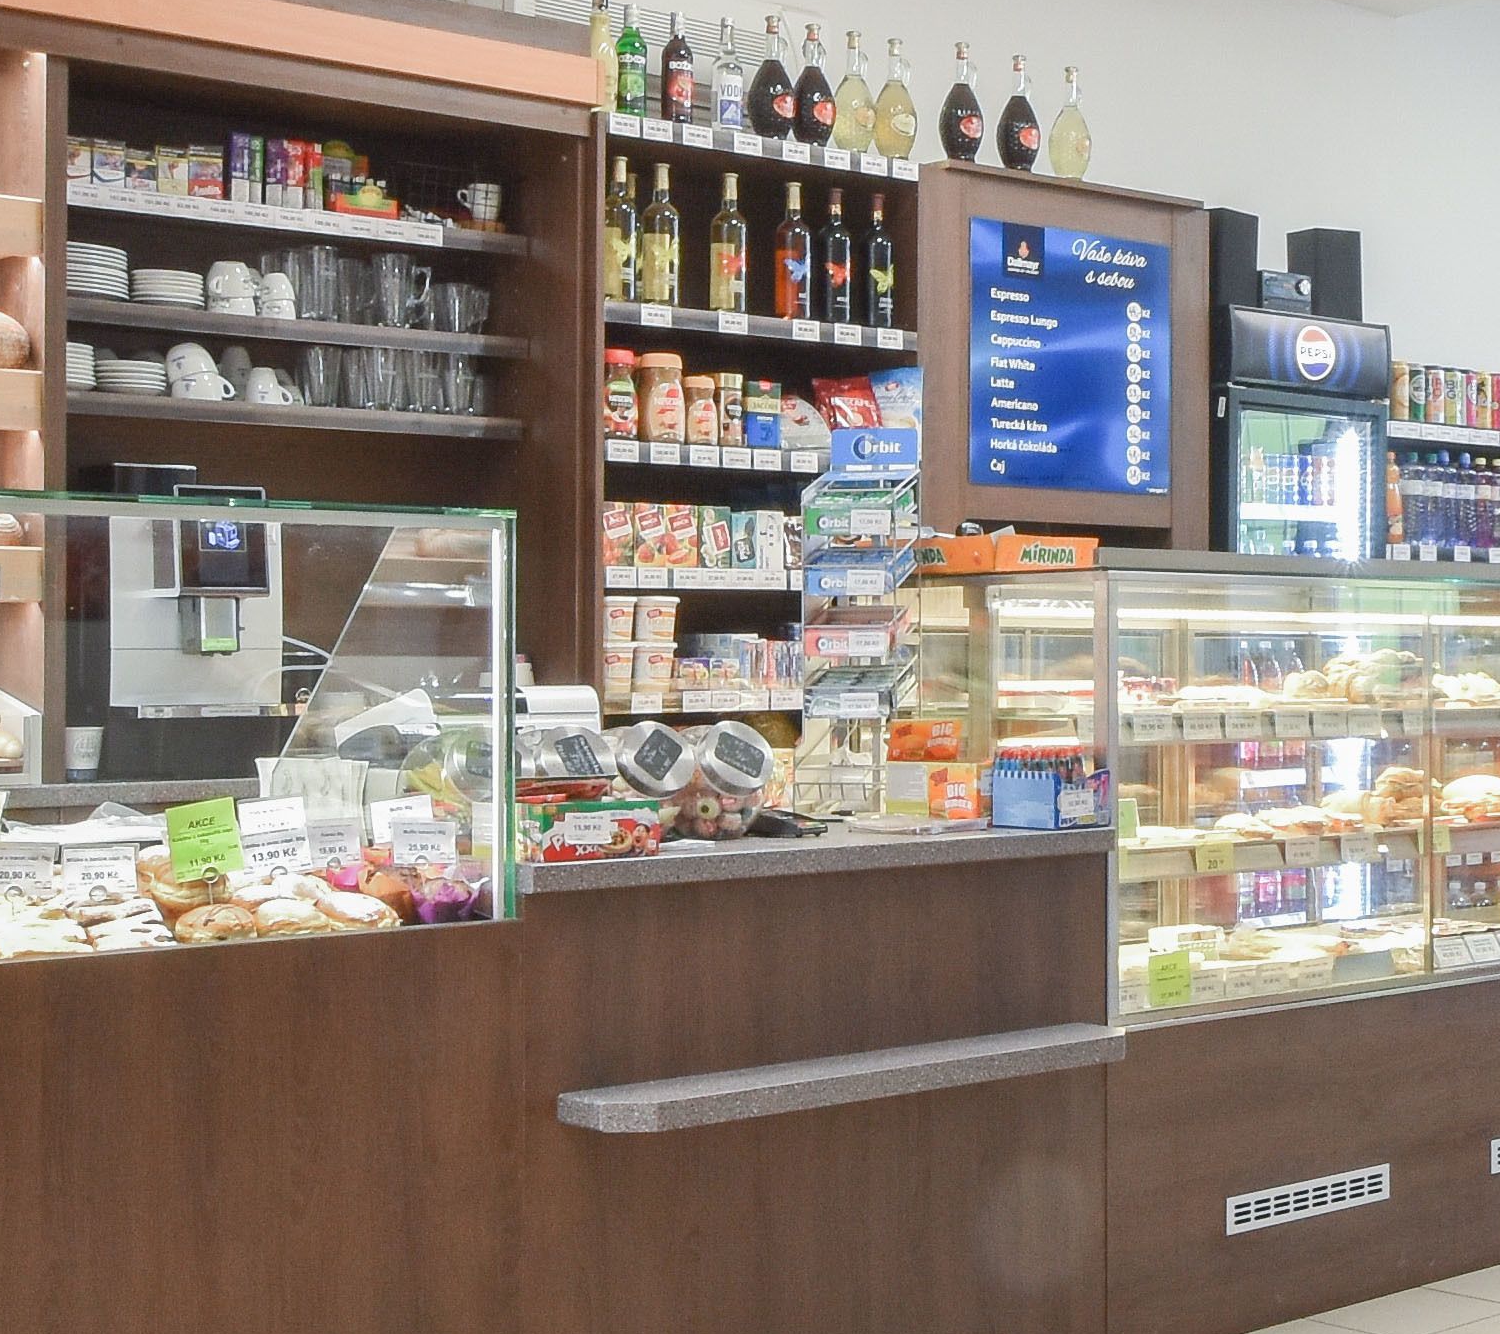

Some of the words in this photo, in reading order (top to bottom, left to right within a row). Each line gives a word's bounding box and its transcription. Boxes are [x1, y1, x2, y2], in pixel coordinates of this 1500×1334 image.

[719, 83, 742, 98] VOD
[1072, 239, 1113, 263] Vaše
[1113, 249, 1148, 268] káva
[1085, 270, 1097, 284] s
[1097, 271, 1136, 290] sebou
[990, 287, 1030, 303] Espresso
[990, 309, 1030, 326] Espresso
[1030, 314, 1059, 330] Lungo
[990, 333, 1042, 350] Cappuccino
[990, 356, 1009, 370] Flat
[1009, 358, 1036, 372] White
[990, 375, 1016, 390] Latte
[990, 397, 1040, 412] Americano
[990, 417, 1026, 432] Turecká
[1026, 420, 1048, 433] káva
[990, 438, 1018, 451] Horká
[1018, 439, 1058, 454] čokoláda
[990, 459, 1006, 475] Čaj
[818, 516, 850, 529] Orbit
[820, 575, 848, 589] Orbi
[818, 637, 850, 651] Orbit
[931, 722, 954, 737] BIG
[946, 783, 966, 797] BIG
[187, 817, 216, 830] AKCE
[283, 847, 298, 858] Kč
